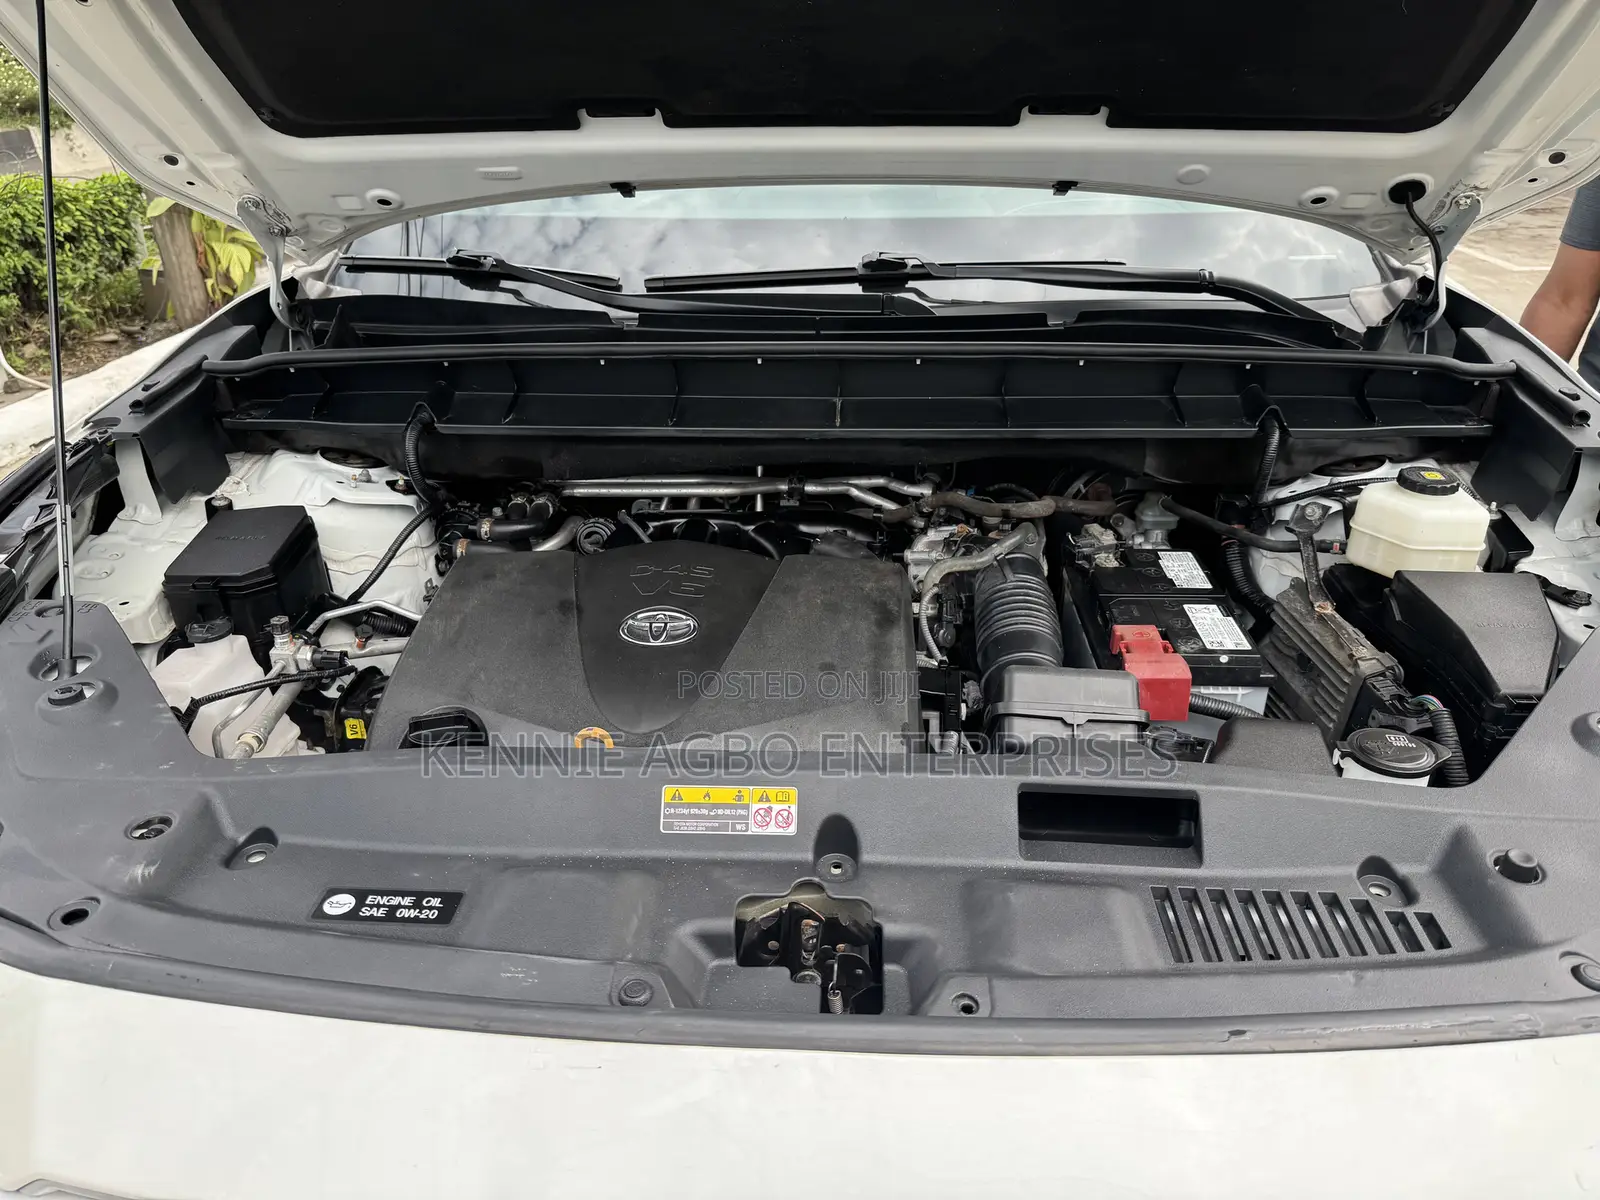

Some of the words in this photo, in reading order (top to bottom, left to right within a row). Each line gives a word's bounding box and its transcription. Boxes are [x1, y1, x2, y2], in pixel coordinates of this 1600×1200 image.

[349, 723, 359, 736] V6
[735, 823, 746, 831] WS
[365, 894, 416, 906] ENGINE
[422, 896, 444, 907] OIL
[358, 907, 389, 917] SAE
[395, 908, 438, 919] 0W-20
